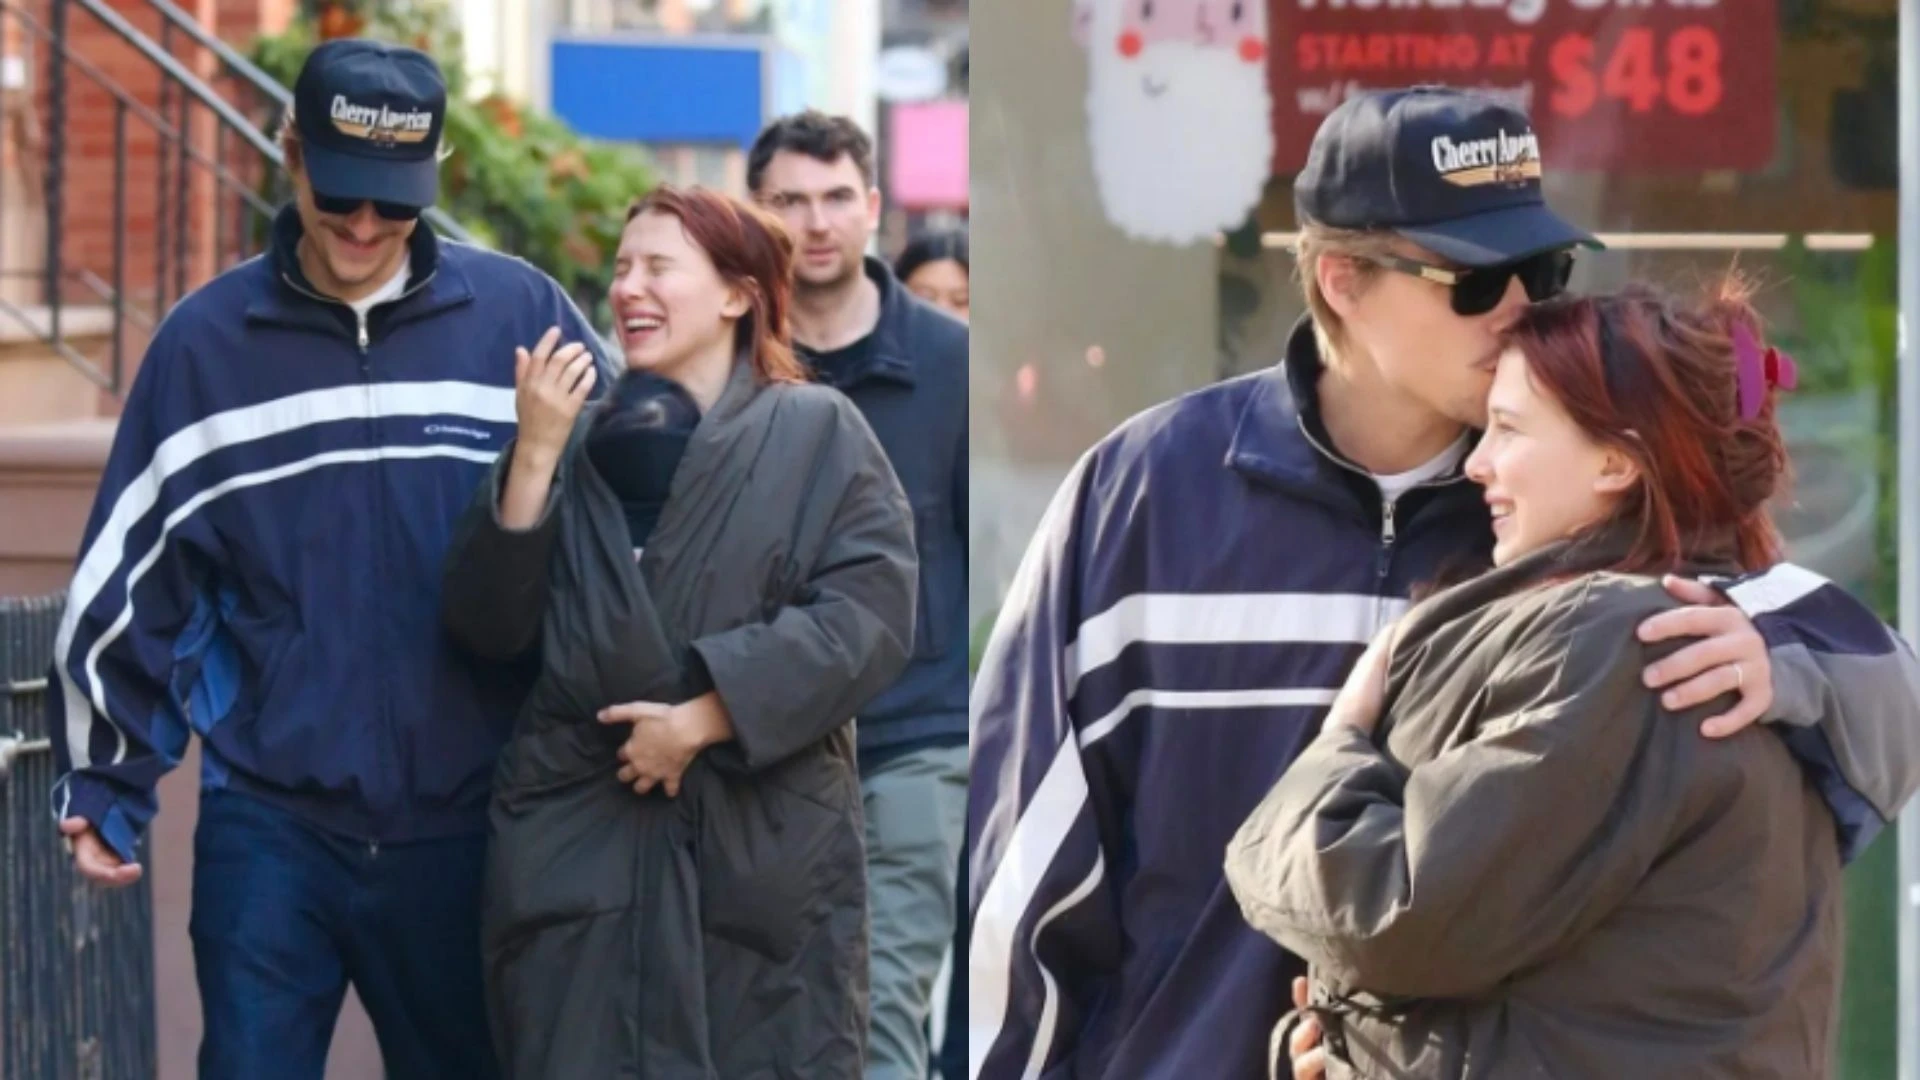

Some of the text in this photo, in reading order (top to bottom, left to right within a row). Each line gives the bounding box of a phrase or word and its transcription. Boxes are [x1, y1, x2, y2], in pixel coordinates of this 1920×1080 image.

[1296, 32, 1534, 71] STARTING AT
[1549, 24, 1724, 119] $48
[330, 94, 433, 132] Cherry American
[1431, 134, 1498, 173] Cherry
